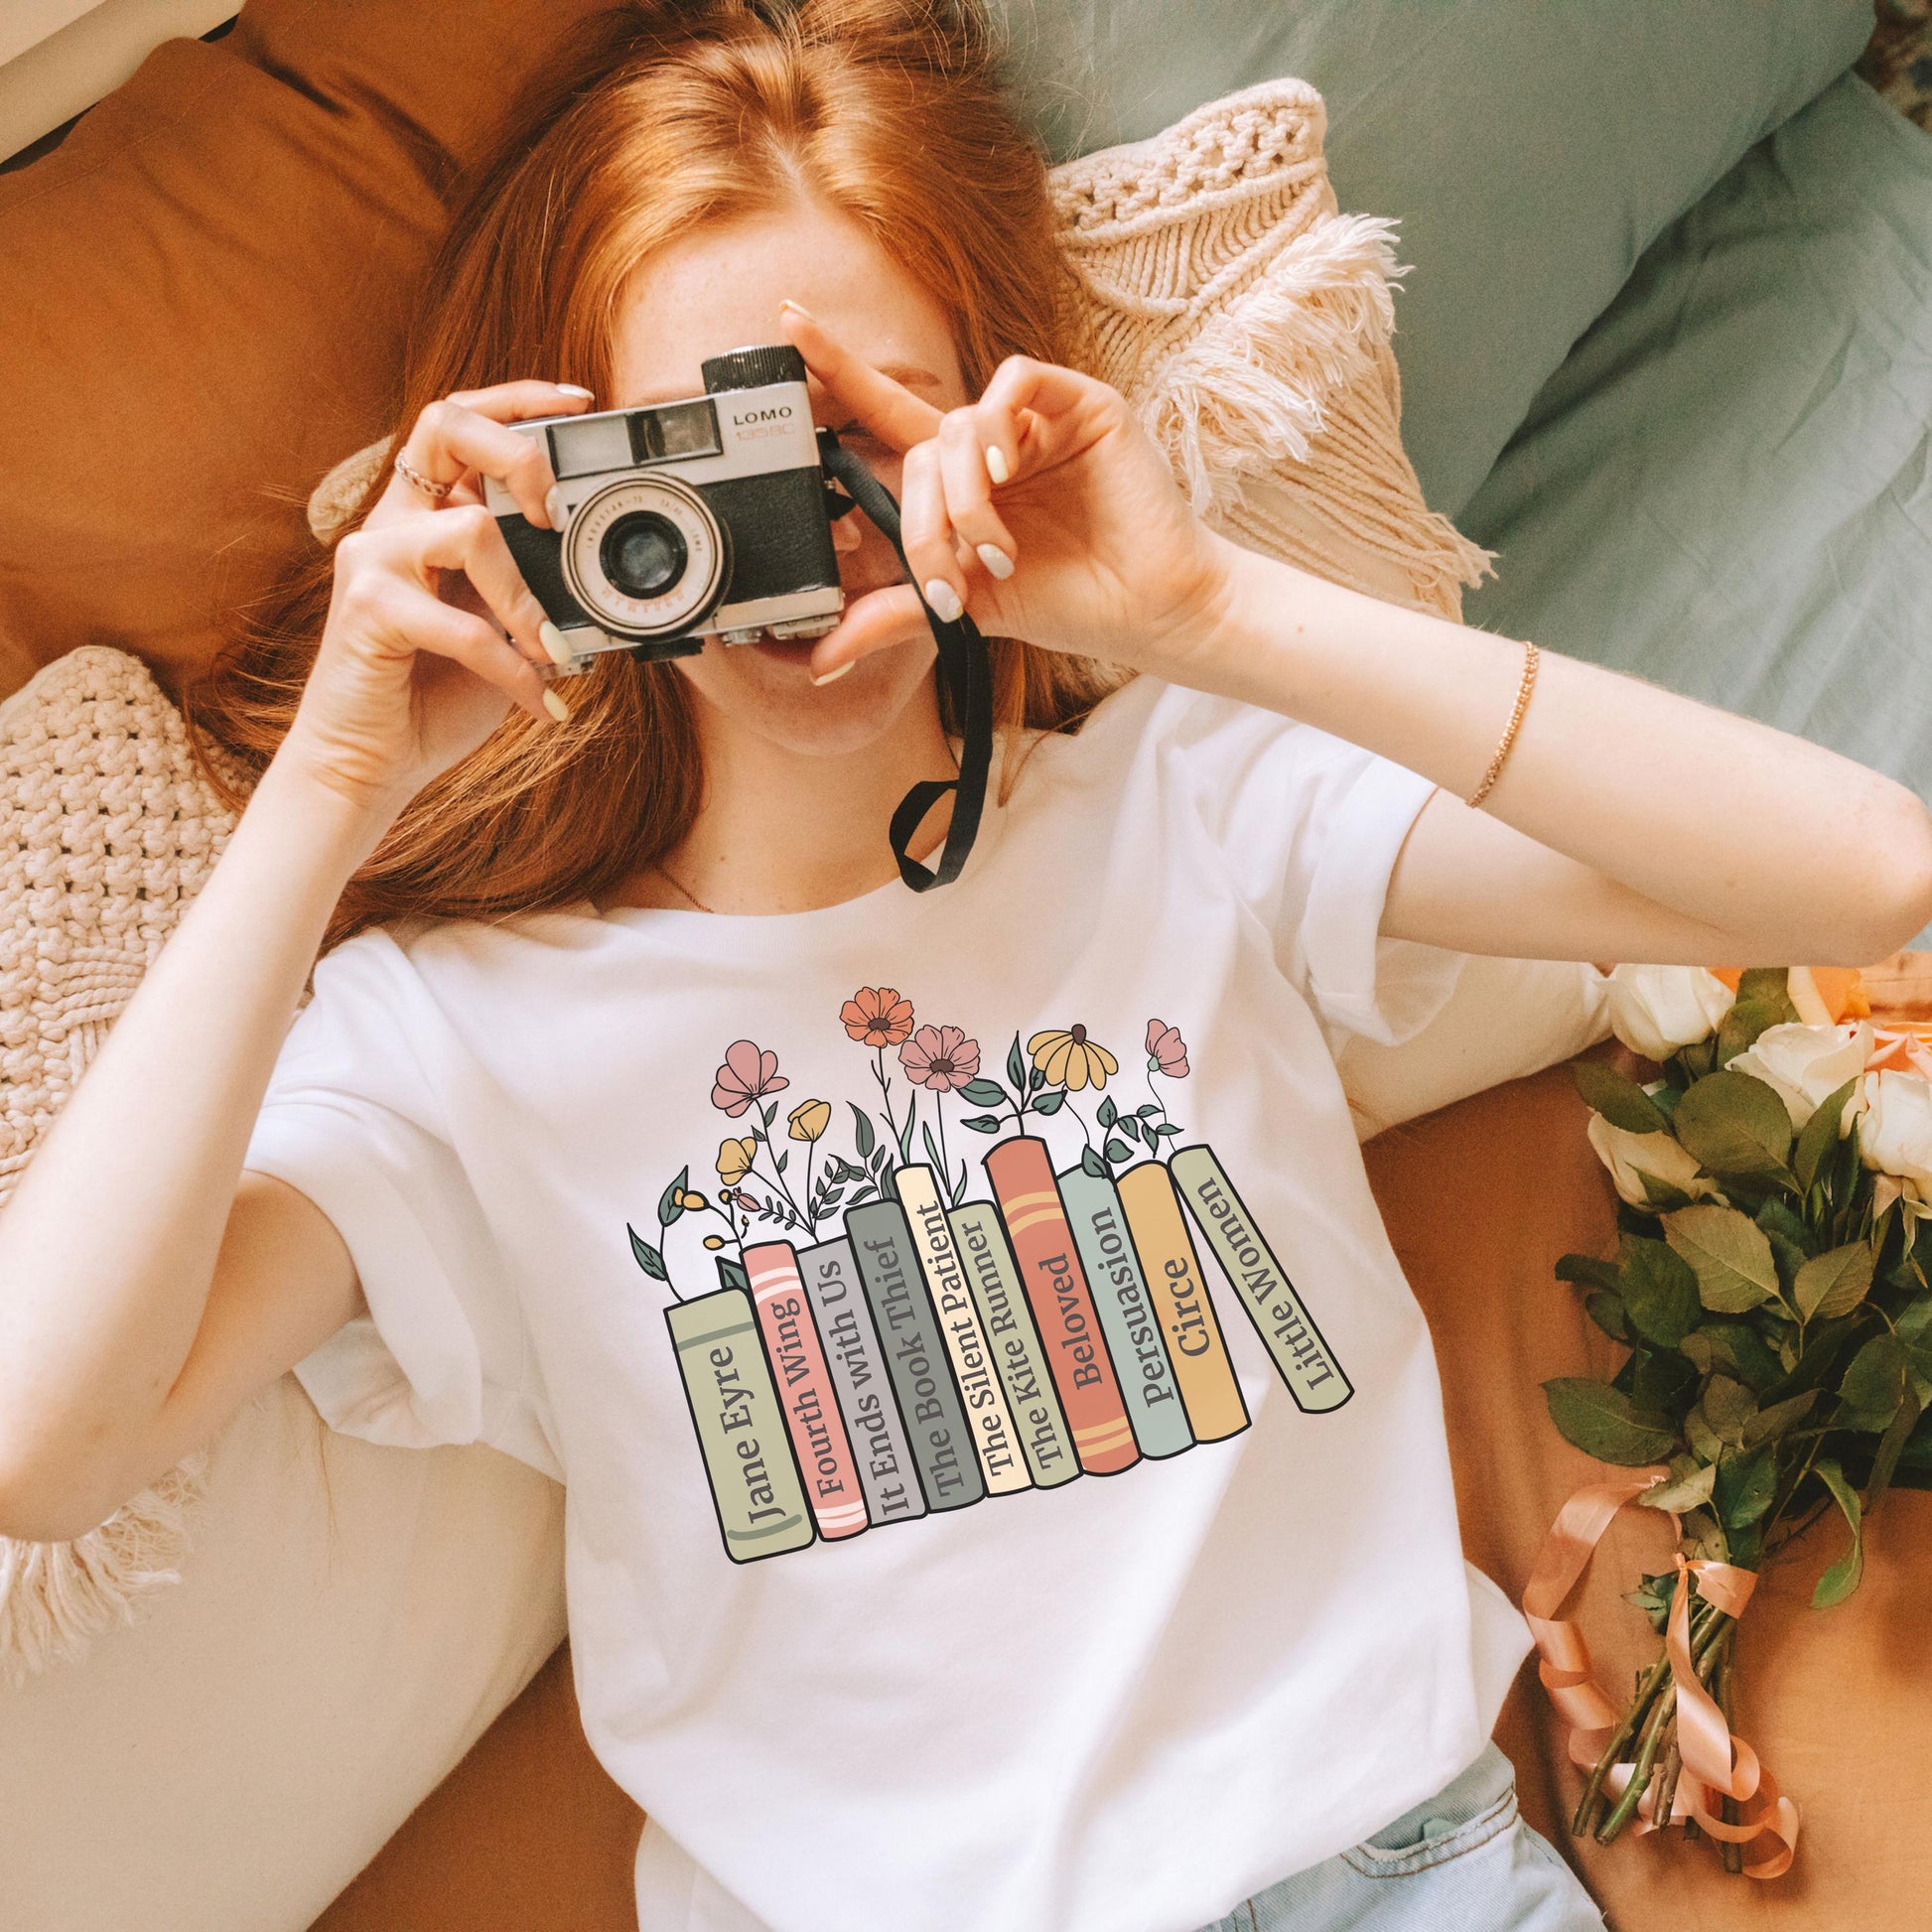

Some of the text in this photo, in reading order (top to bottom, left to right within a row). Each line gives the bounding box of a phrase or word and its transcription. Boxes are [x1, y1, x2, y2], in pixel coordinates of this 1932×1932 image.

[733, 406, 792, 426] LOMO
[864, 1236, 964, 1497] The Book Thief
[916, 1200, 1015, 1476] The Silent Patient
[962, 1220, 1063, 1469] The Kite Runner
[1038, 1253, 1102, 1390] Beloved
[1091, 1207, 1174, 1408] Persuasion
[1165, 1257, 1210, 1356] Circe
[1197, 1176, 1334, 1390] Little Women
[710, 1345, 786, 1525] Jane Eyre
[770, 1297, 845, 1498] Fourth Wing
[818, 1260, 909, 1516] It Ends with Us
